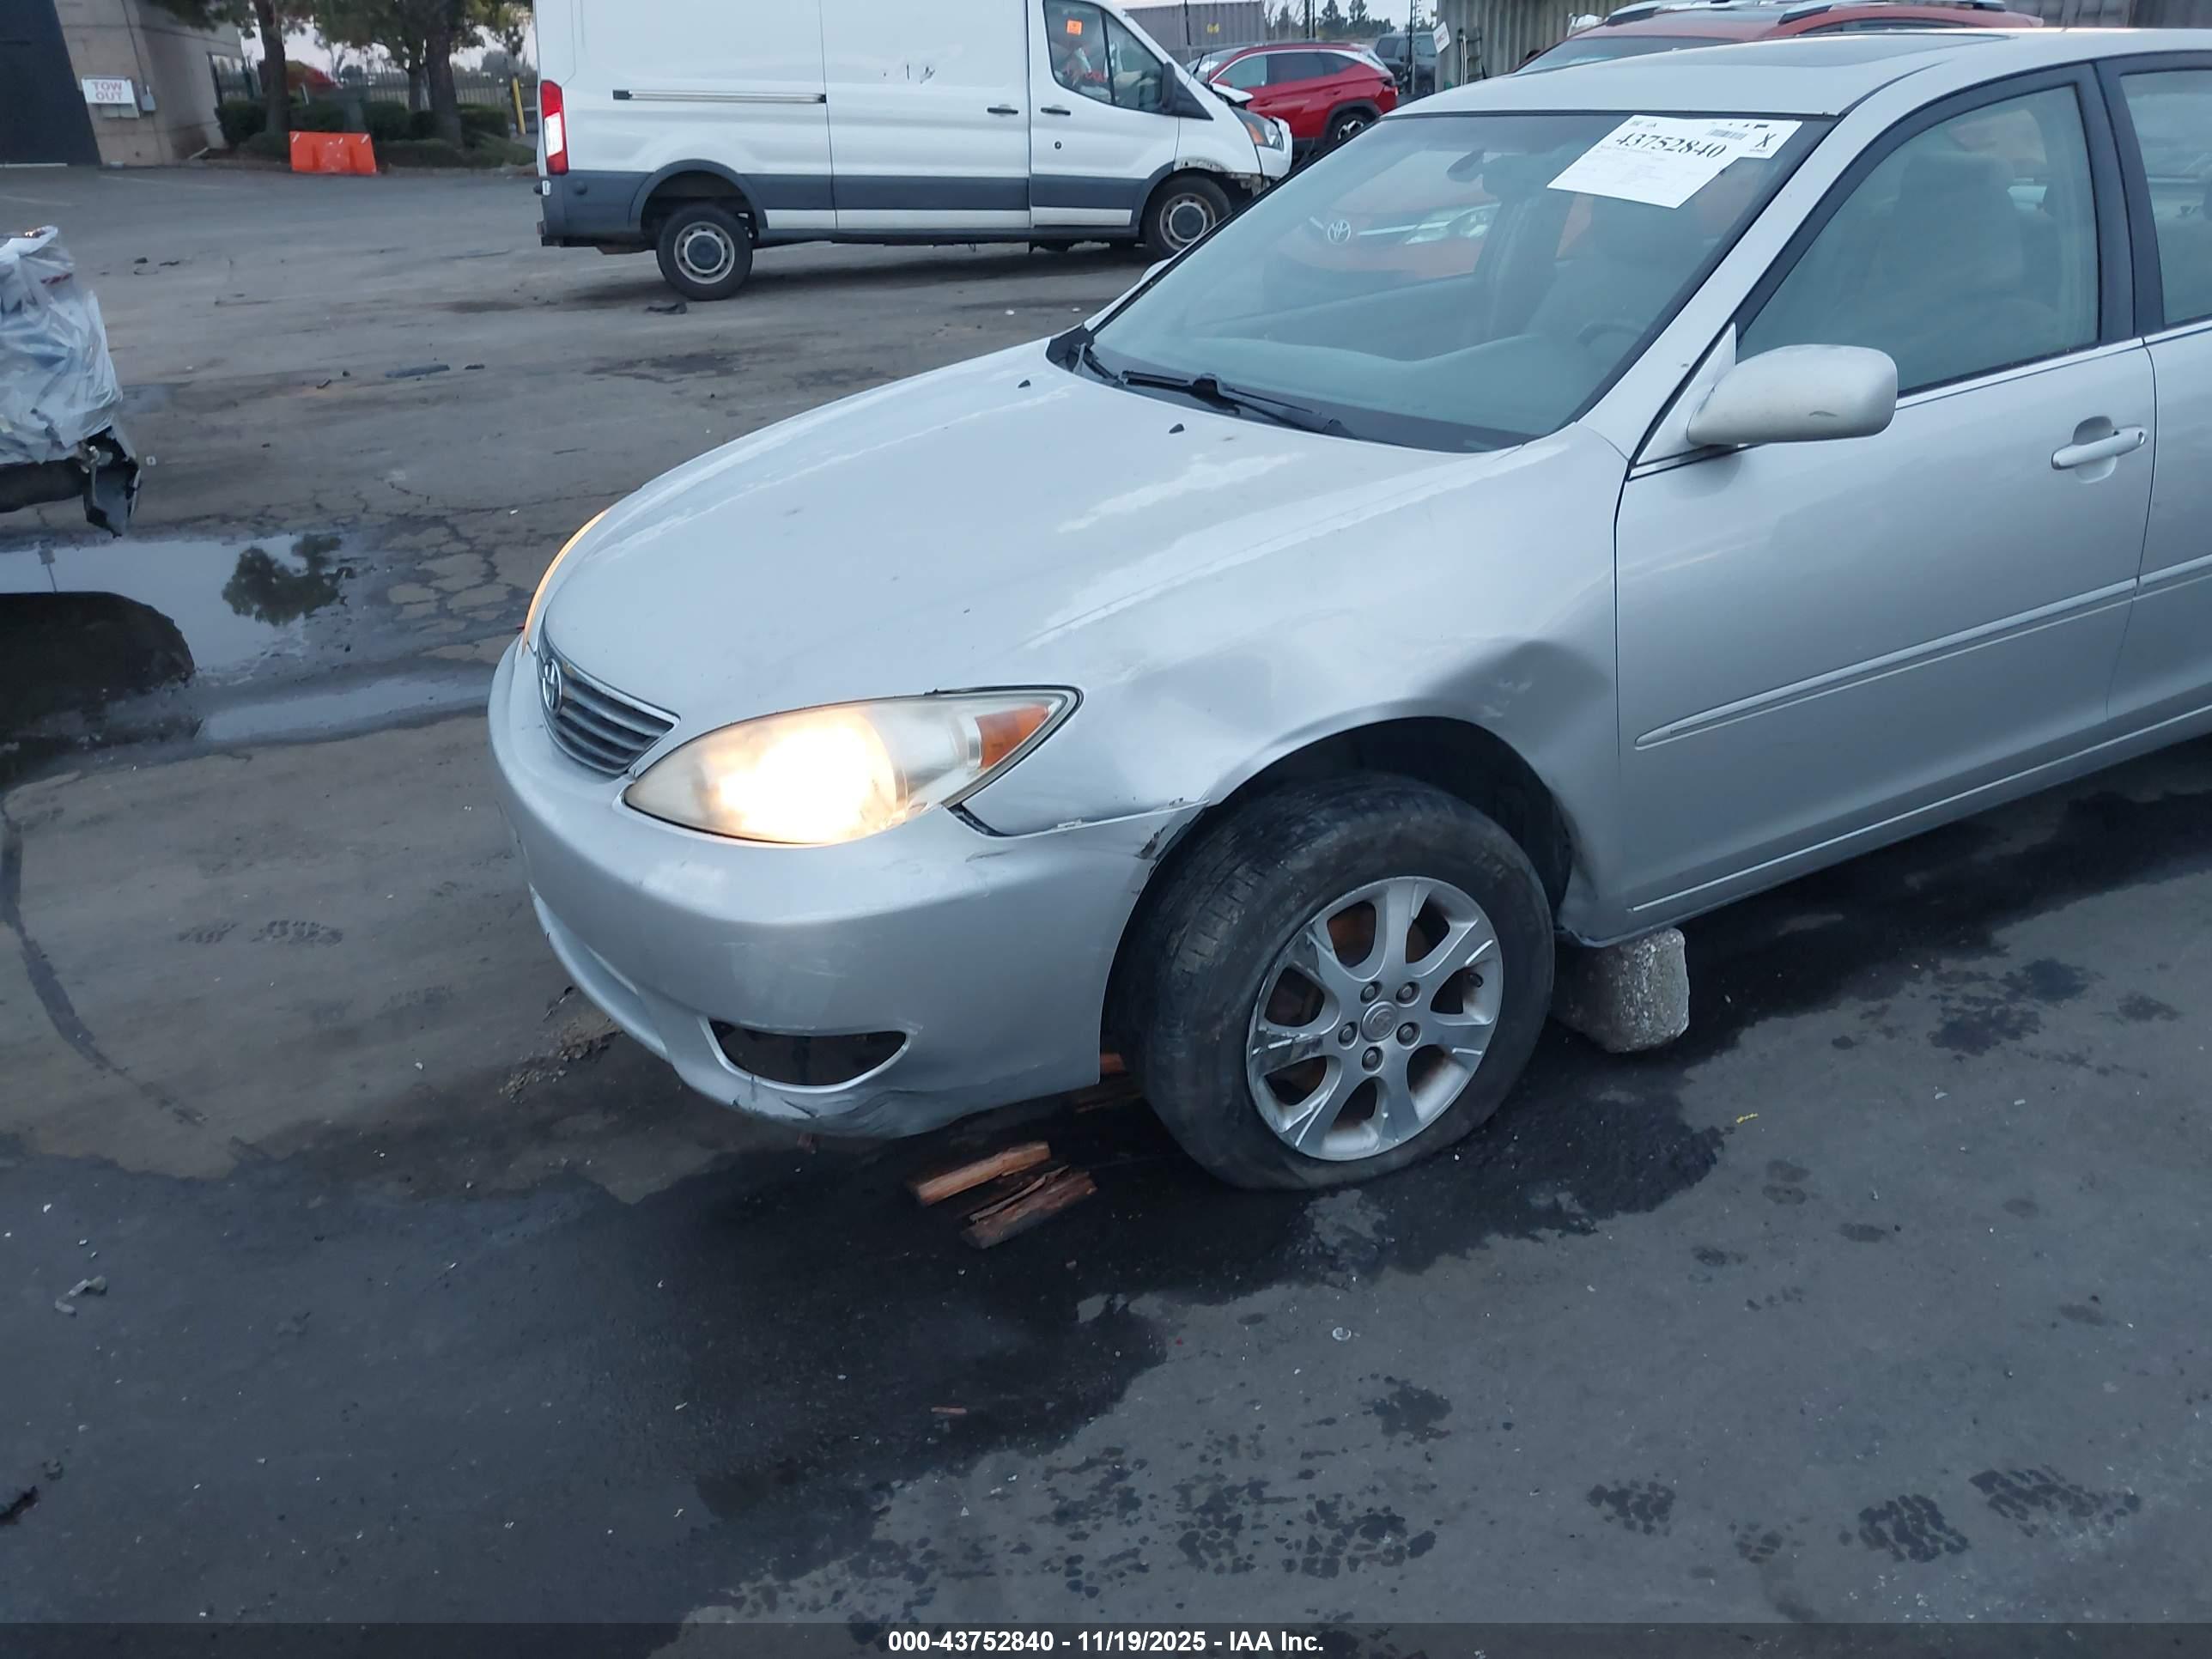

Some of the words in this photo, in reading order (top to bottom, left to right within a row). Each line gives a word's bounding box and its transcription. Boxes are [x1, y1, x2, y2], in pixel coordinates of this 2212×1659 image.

[92, 82, 122, 90] TOW
[95, 91, 122, 101] OUT
[1616, 132, 1727, 158] 43752840
[1754, 132, 1778, 148] X
